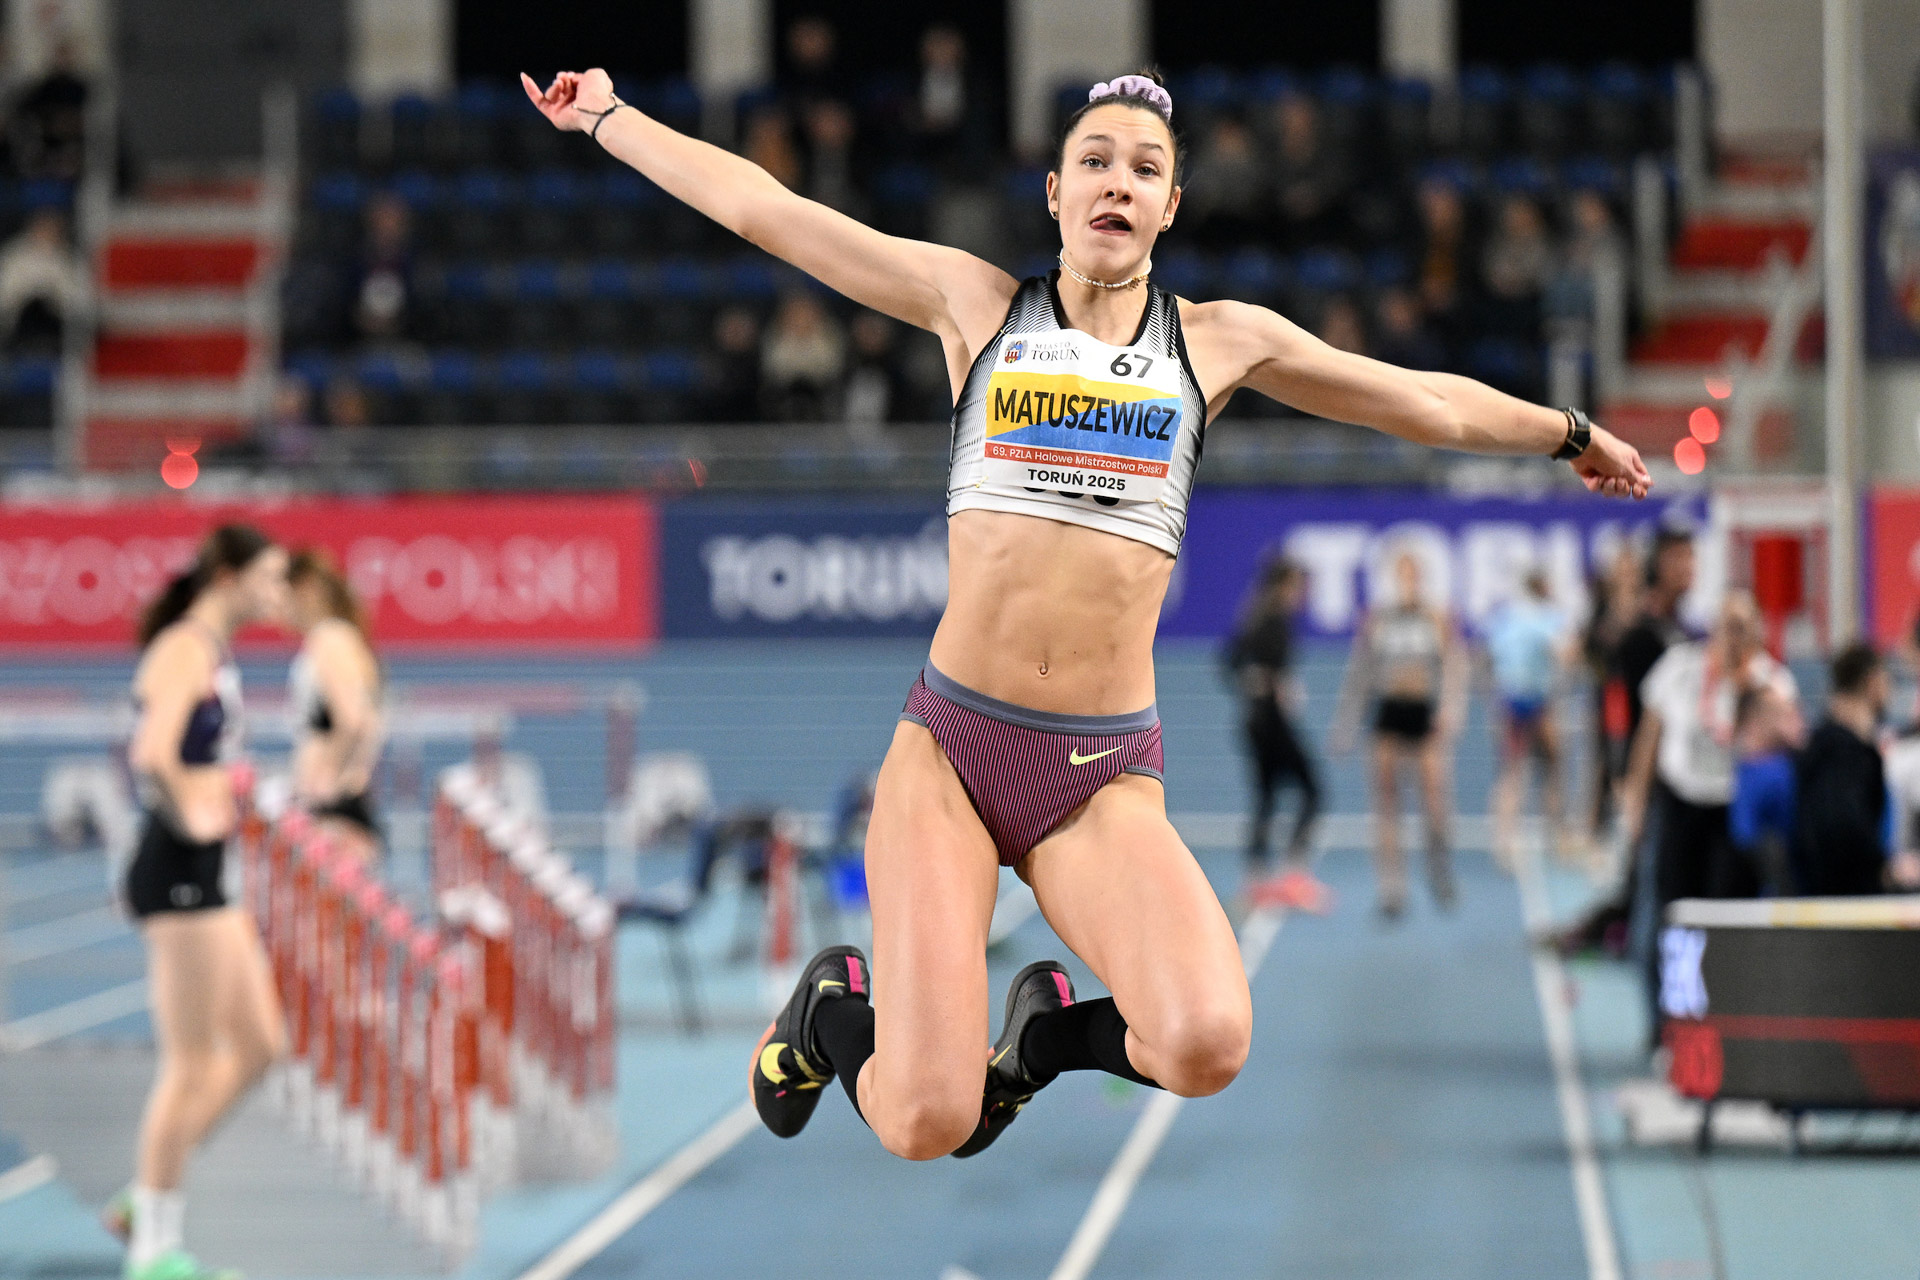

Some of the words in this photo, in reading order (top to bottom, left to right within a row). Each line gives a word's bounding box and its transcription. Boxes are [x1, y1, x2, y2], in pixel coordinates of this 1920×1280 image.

[1031, 346, 1081, 361] TORUŃ
[1035, 341, 1071, 350] MIASTO
[1110, 353, 1154, 379] 67
[994, 387, 1177, 441] MATUSZEWICZ
[992, 446, 1008, 457] 69.
[1009, 448, 1033, 460] PZLA
[1035, 451, 1073, 464] Halowe
[1075, 455, 1136, 472] Mistrzostwa
[1137, 463, 1164, 475] Polski
[1027, 468, 1084, 486] TORUŃ
[1087, 475, 1126, 491] 2025
